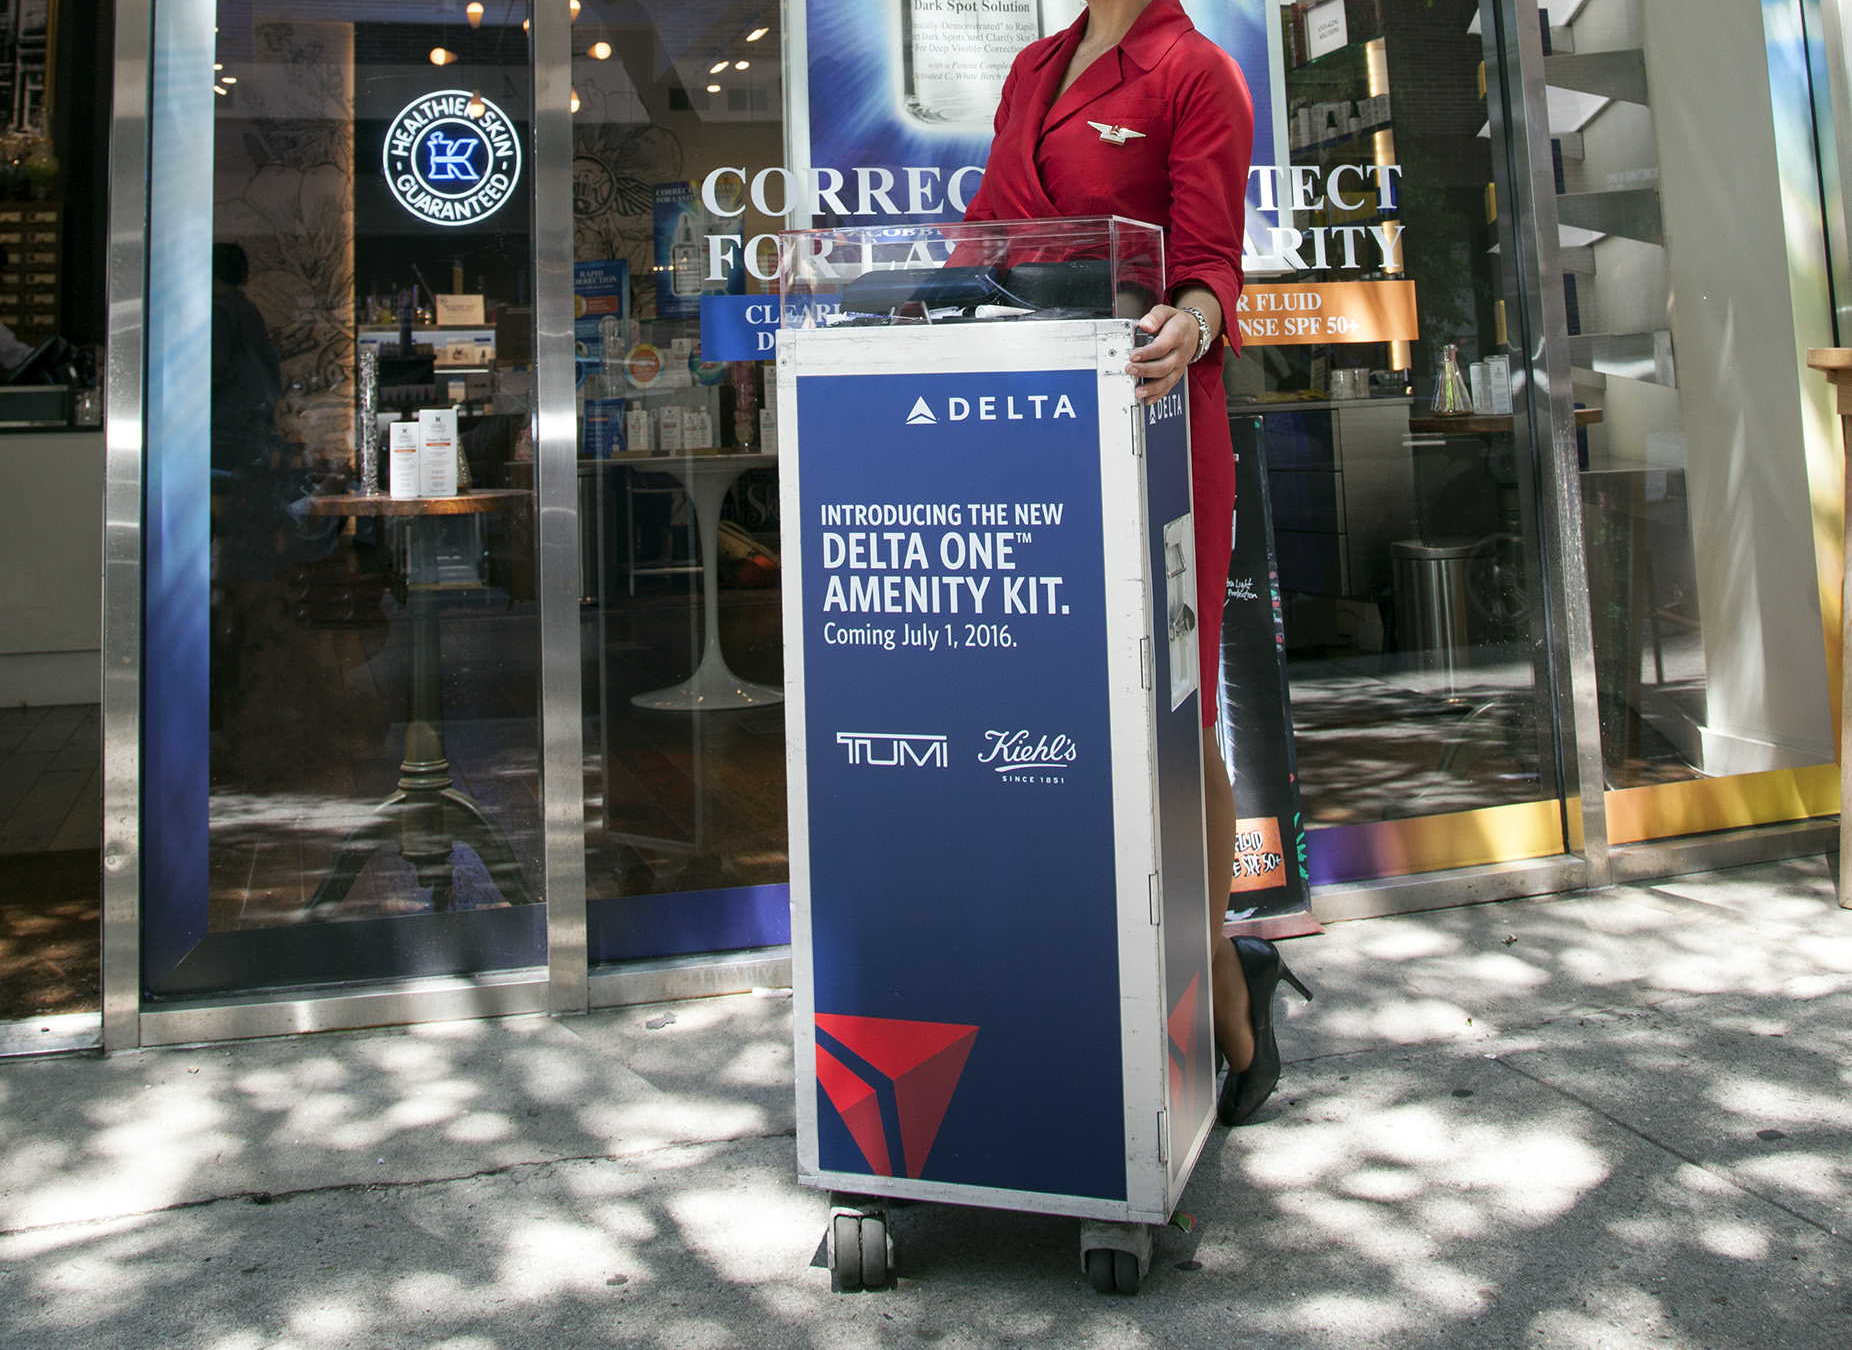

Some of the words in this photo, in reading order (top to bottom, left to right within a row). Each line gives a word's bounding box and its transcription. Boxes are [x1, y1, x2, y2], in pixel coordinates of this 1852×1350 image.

[914, 0, 943, 11] Dark
[947, 0, 978, 14] Spot
[982, 0, 1030, 13] Solution
[922, 33, 943, 41] Dark
[945, 33, 965, 42] Spots
[967, 33, 983, 41] and
[986, 33, 1015, 43] Clarify
[1016, 34, 1031, 42] Skin
[1005, 23, 1014, 31] to
[915, 44, 927, 52] For
[928, 44, 949, 54] Deep
[951, 44, 982, 53] Visible
[479, 110, 514, 158] SKIN
[396, 173, 510, 221] GUARANTEED
[701, 165, 986, 217] CORREC
[1248, 164, 1403, 212] TECT
[704, 233, 841, 282] FOR
[1256, 292, 1322, 312] FLUID
[1237, 318, 1280, 337] NSE
[1284, 317, 1322, 336] SPF
[1326, 315, 1360, 334] 50+
[949, 394, 1077, 421] DELTA
[1157, 393, 1183, 420] DELTA
[820, 503, 962, 526] INTRODUCING
[967, 503, 1009, 526] THE
[1014, 503, 1064, 526] NEW
[822, 531, 930, 570] DELTA
[822, 575, 992, 614] AMENITY
[1003, 576, 1070, 615] KIT.
[823, 621, 896, 651] Coming
[901, 623, 940, 652] July
[944, 624, 958, 649] 1,
[964, 624, 1018, 648] 2016.
[836, 731, 948, 768] TUMI
[977, 729, 1077, 763] Kiehl's
[1002, 775, 1035, 783] SINCE
[1040, 776, 1065, 784] 1851
[1241, 853, 1261, 877] SPF
[1261, 852, 1283, 873] 50+
